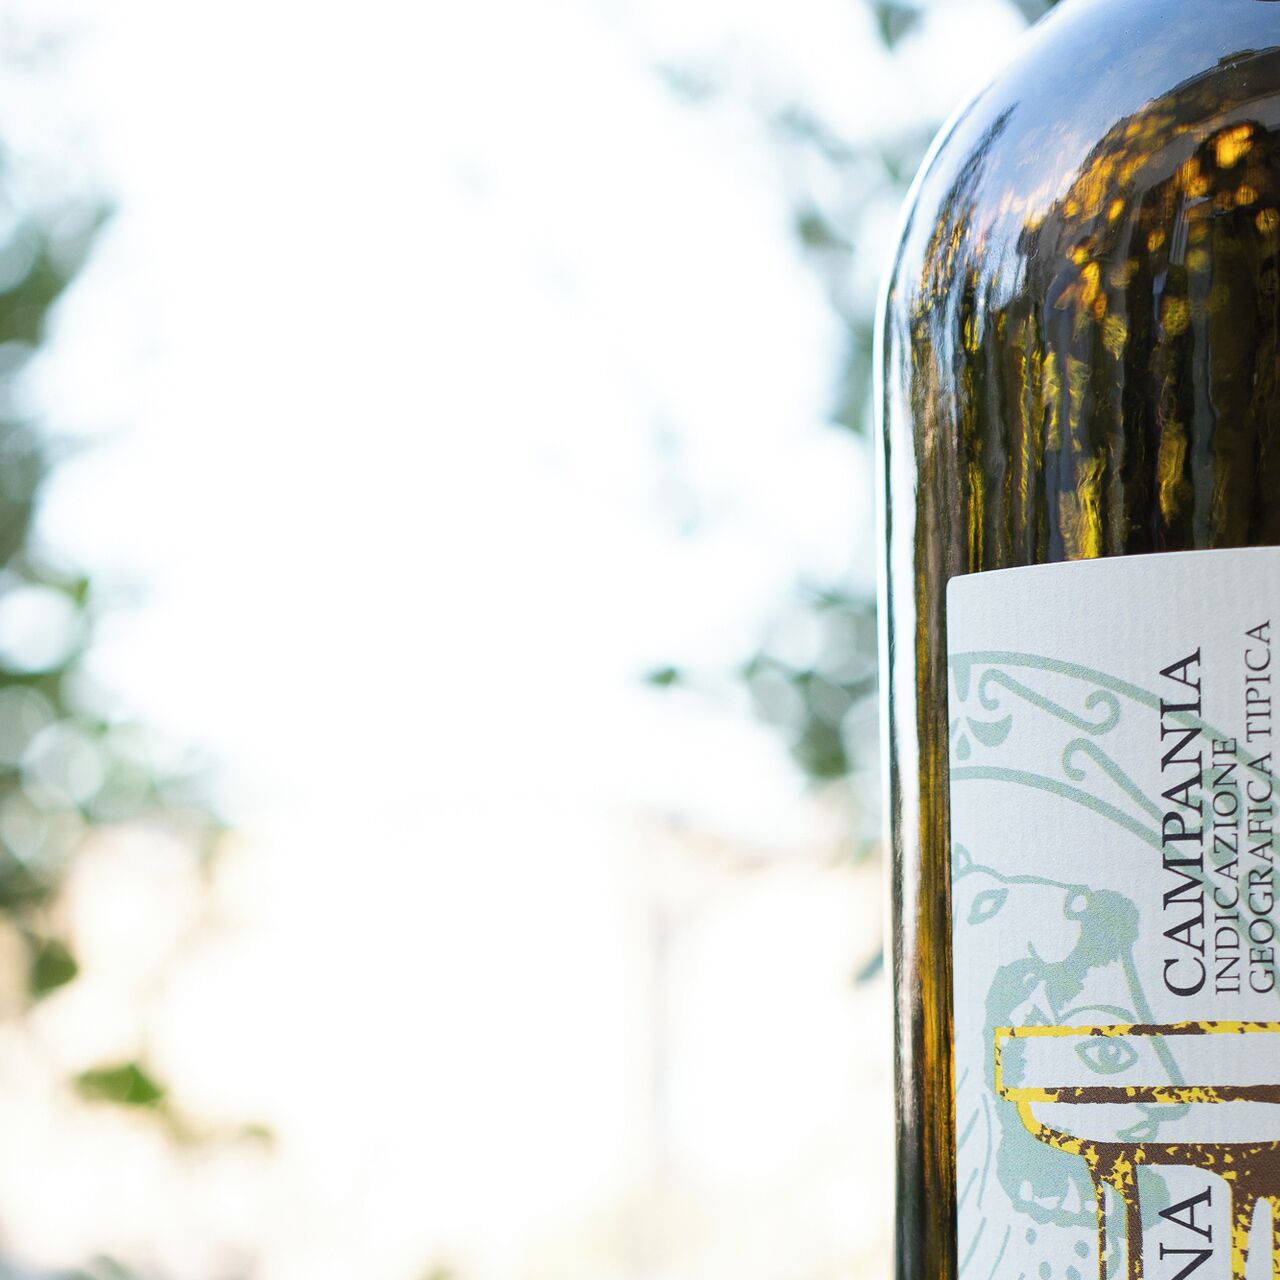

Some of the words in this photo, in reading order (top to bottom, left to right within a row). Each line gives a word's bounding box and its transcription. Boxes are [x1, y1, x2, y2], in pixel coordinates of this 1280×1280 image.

[1244, 619, 1272, 744] TIPICA
[1158, 646, 1206, 998] CAMPANIA
[1211, 736, 1241, 996] INDICAZIONE
[1245, 752, 1275, 995] GEOGRAFICA
